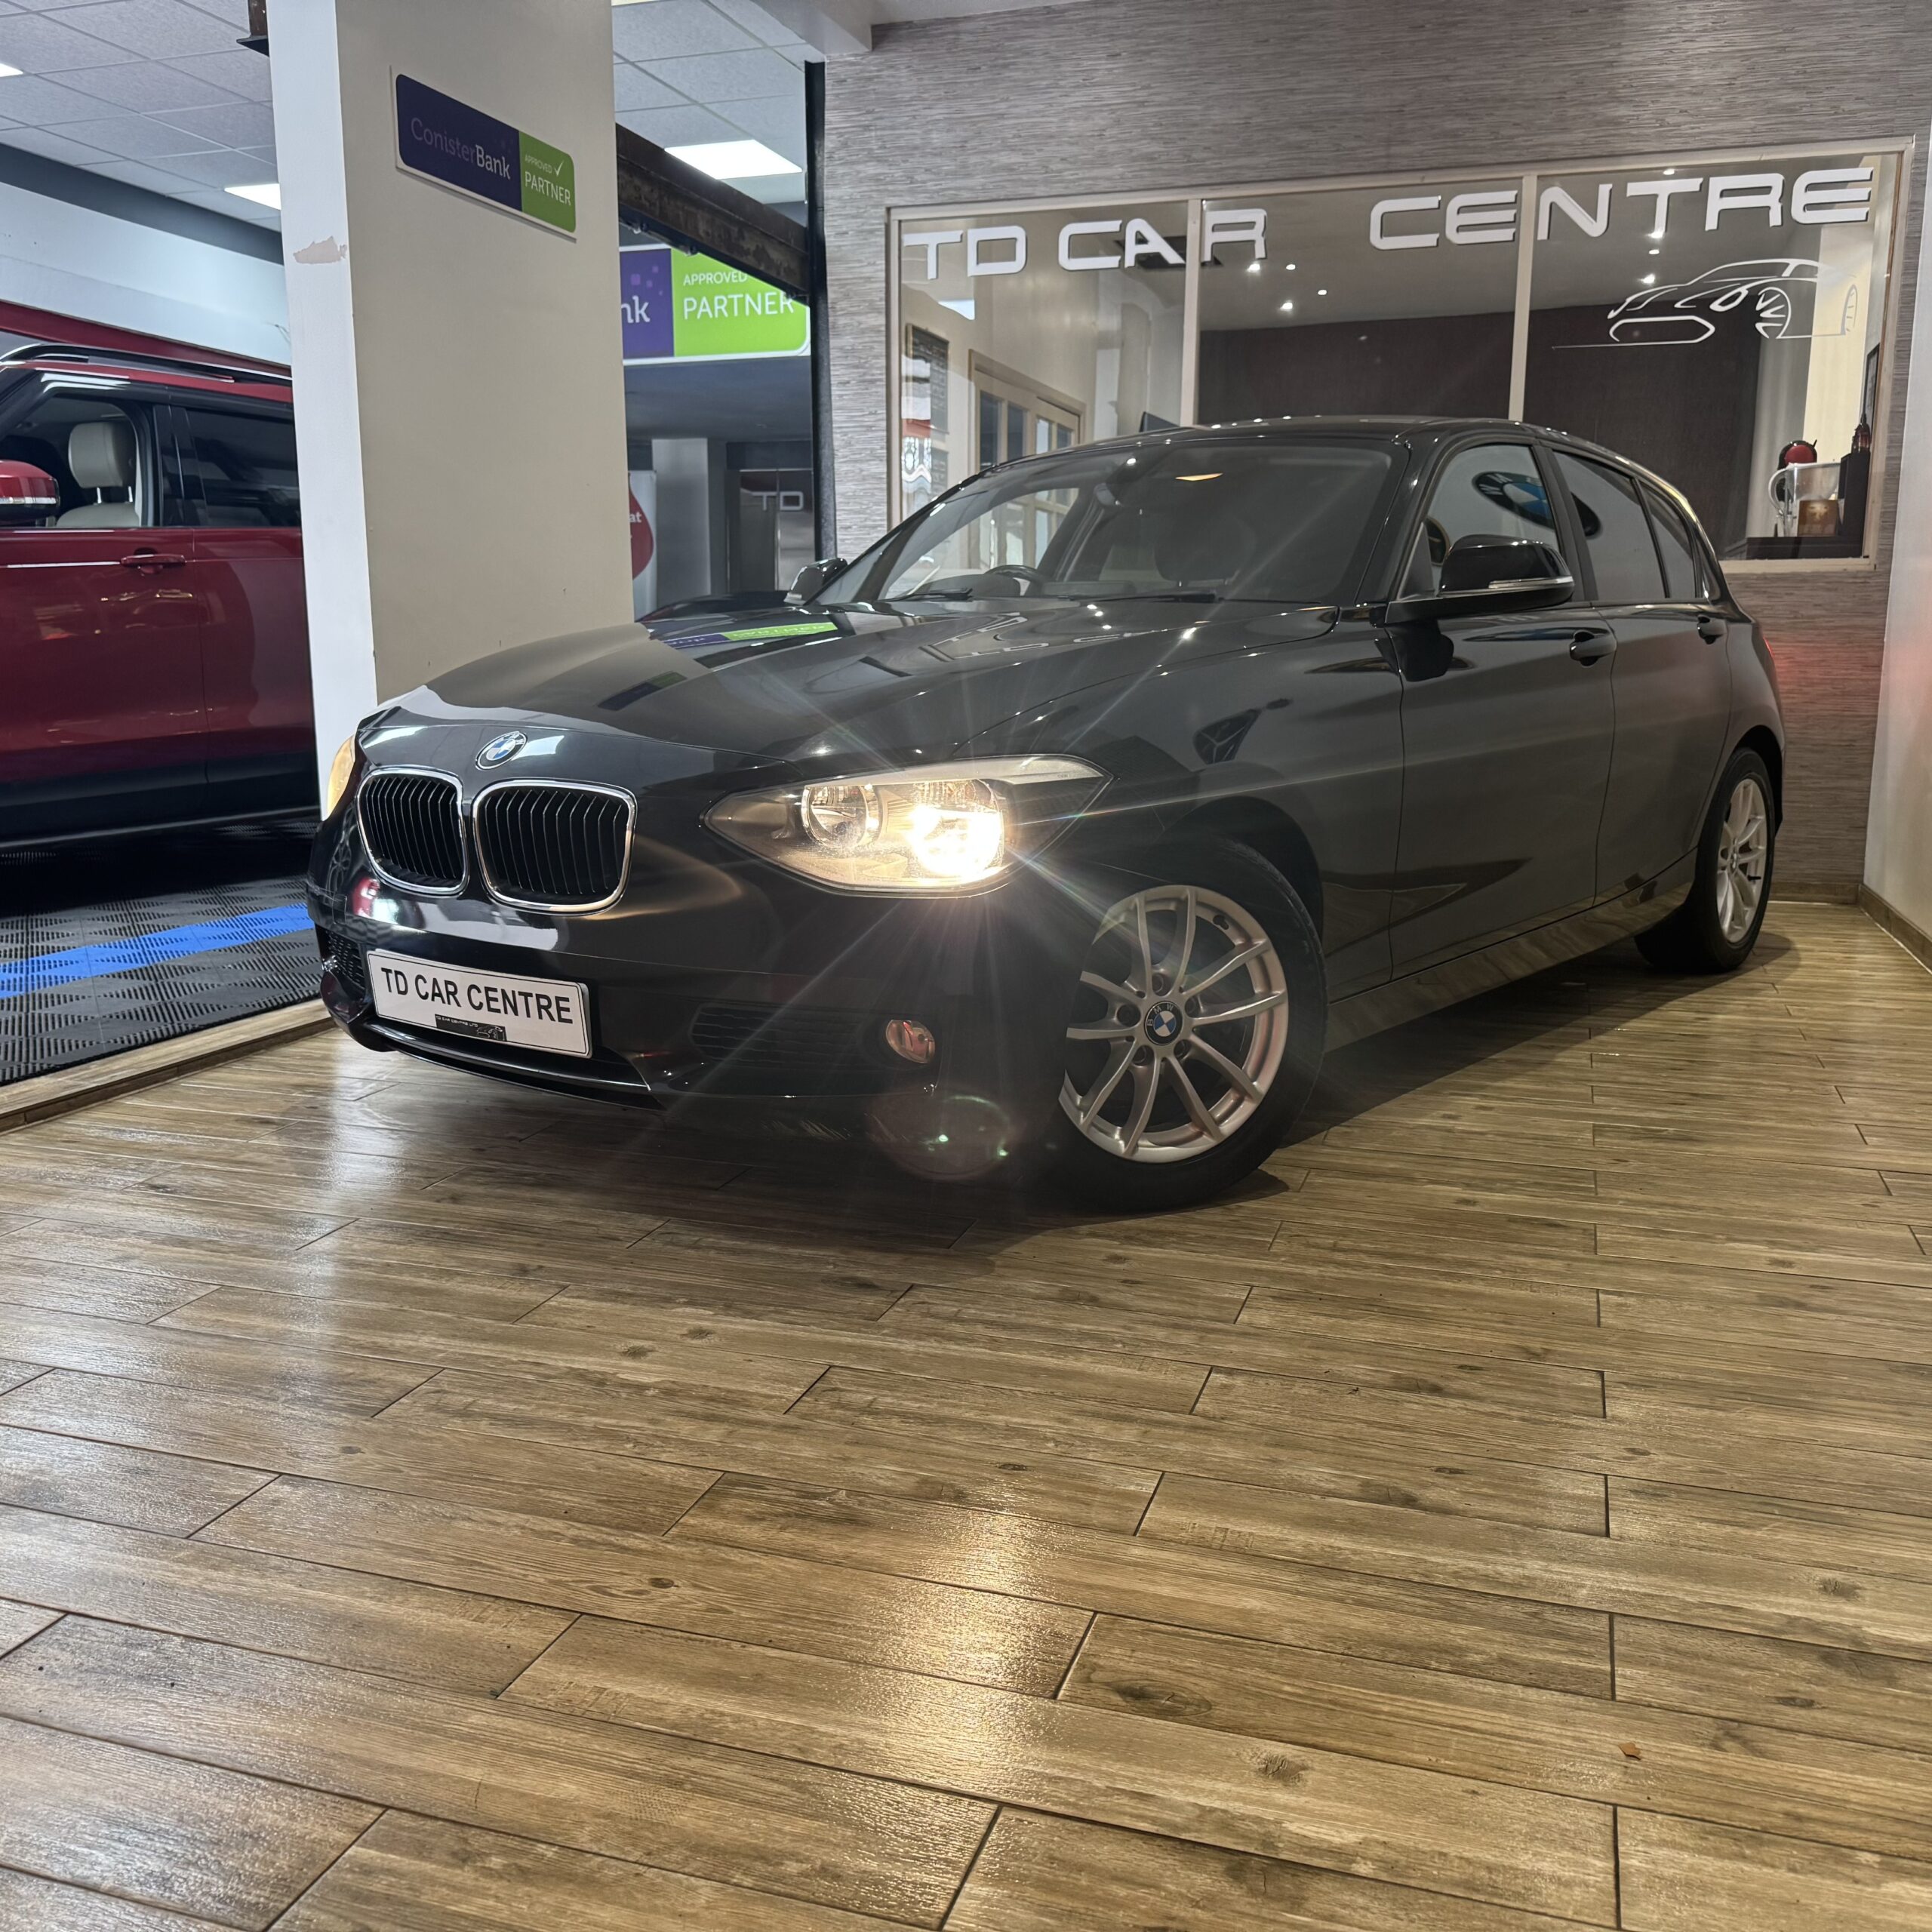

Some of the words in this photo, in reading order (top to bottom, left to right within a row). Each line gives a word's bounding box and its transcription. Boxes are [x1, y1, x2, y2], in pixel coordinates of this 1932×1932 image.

[525, 154, 553, 174] APPROVED
[525, 171, 571, 206] PARTNER
[903, 226, 1027, 280] TD
[1058, 208, 1268, 271] CAR
[1369, 167, 1875, 251] CENTRE
[683, 272, 748, 286] APPROVED
[684, 291, 795, 320] PARTNER
[752, 491, 804, 511] TD
[380, 967, 409, 995] TD
[415, 974, 462, 1008] CAR
[467, 983, 574, 1024] CENTRE
[1146, 1004, 1174, 1026] BMW
